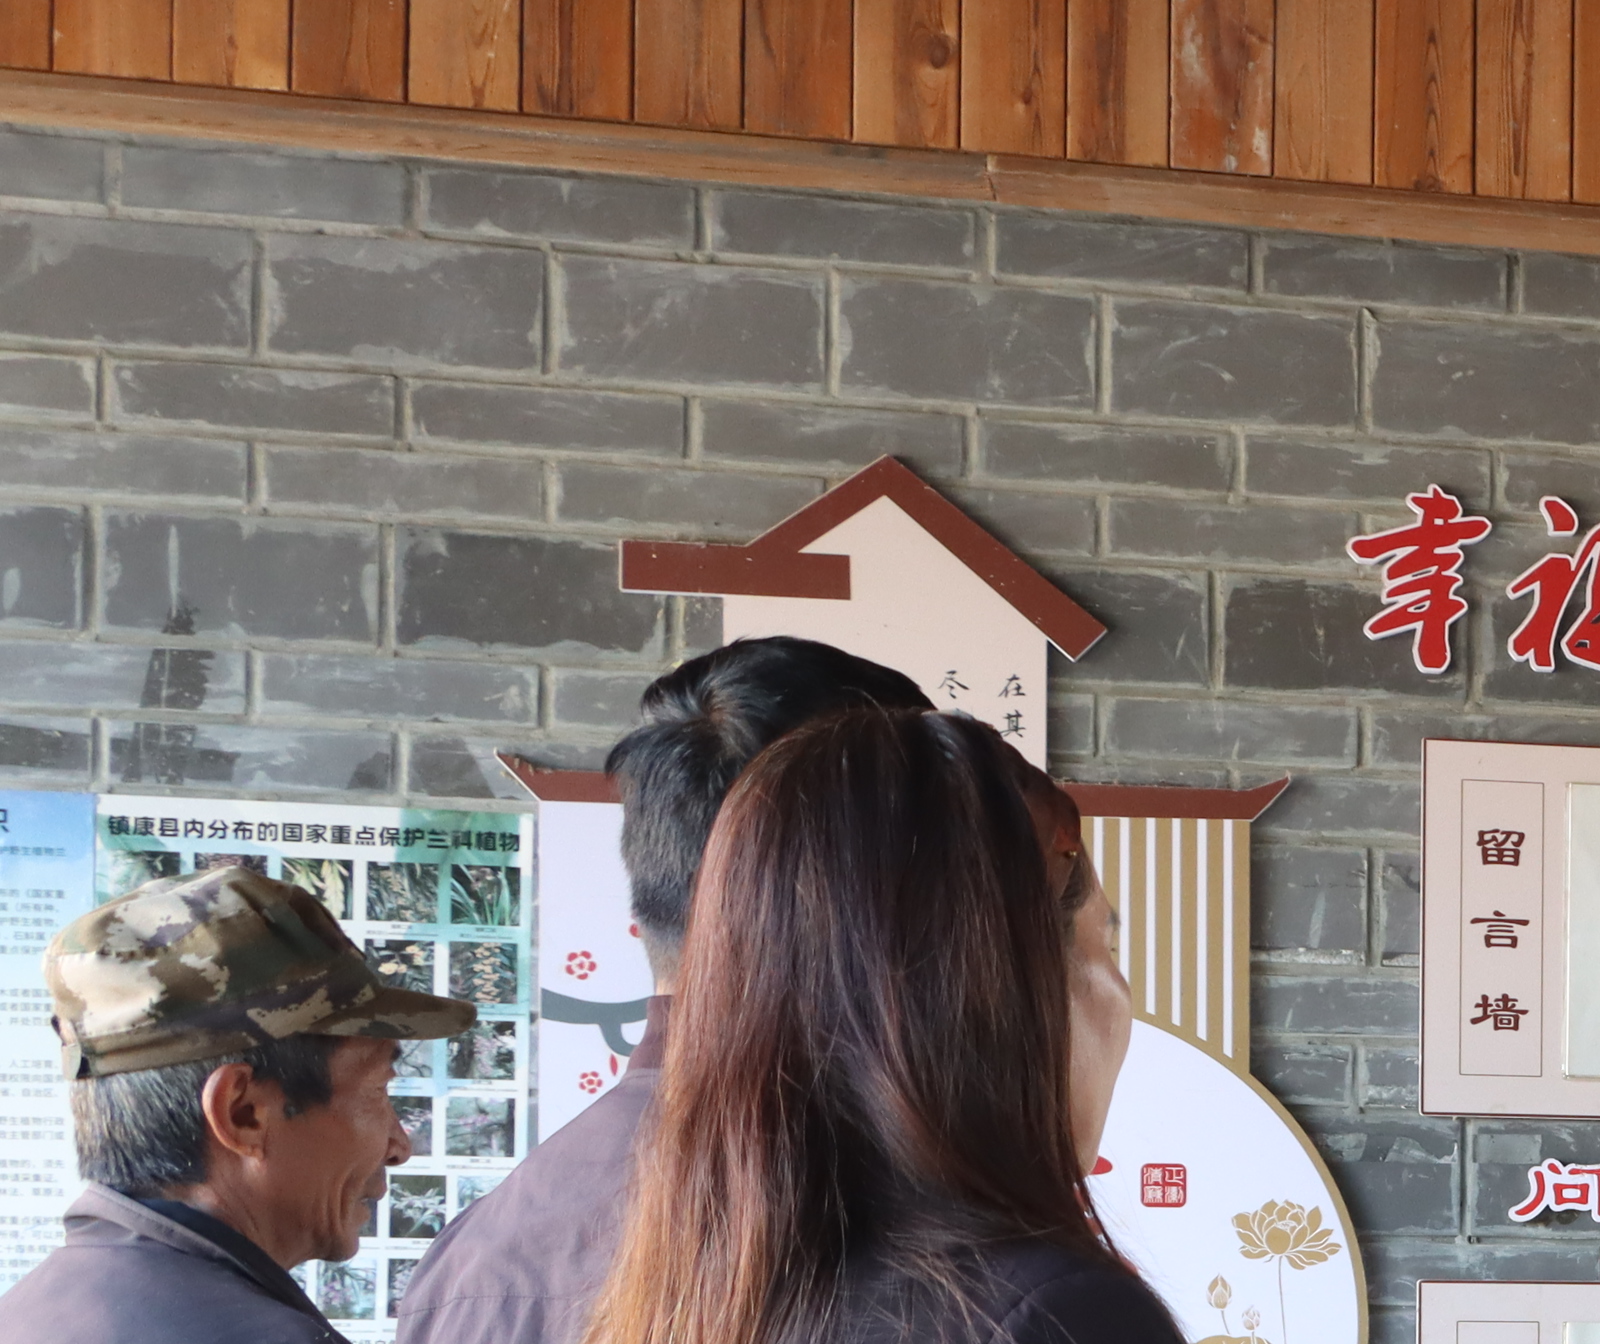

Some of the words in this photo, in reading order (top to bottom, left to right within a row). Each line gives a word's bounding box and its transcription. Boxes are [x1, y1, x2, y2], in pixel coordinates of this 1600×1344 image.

[108, 814, 521, 853] 镇康县内分布的国家重点保护兰科植物
[1470, 829, 1530, 1031] 留言墙
